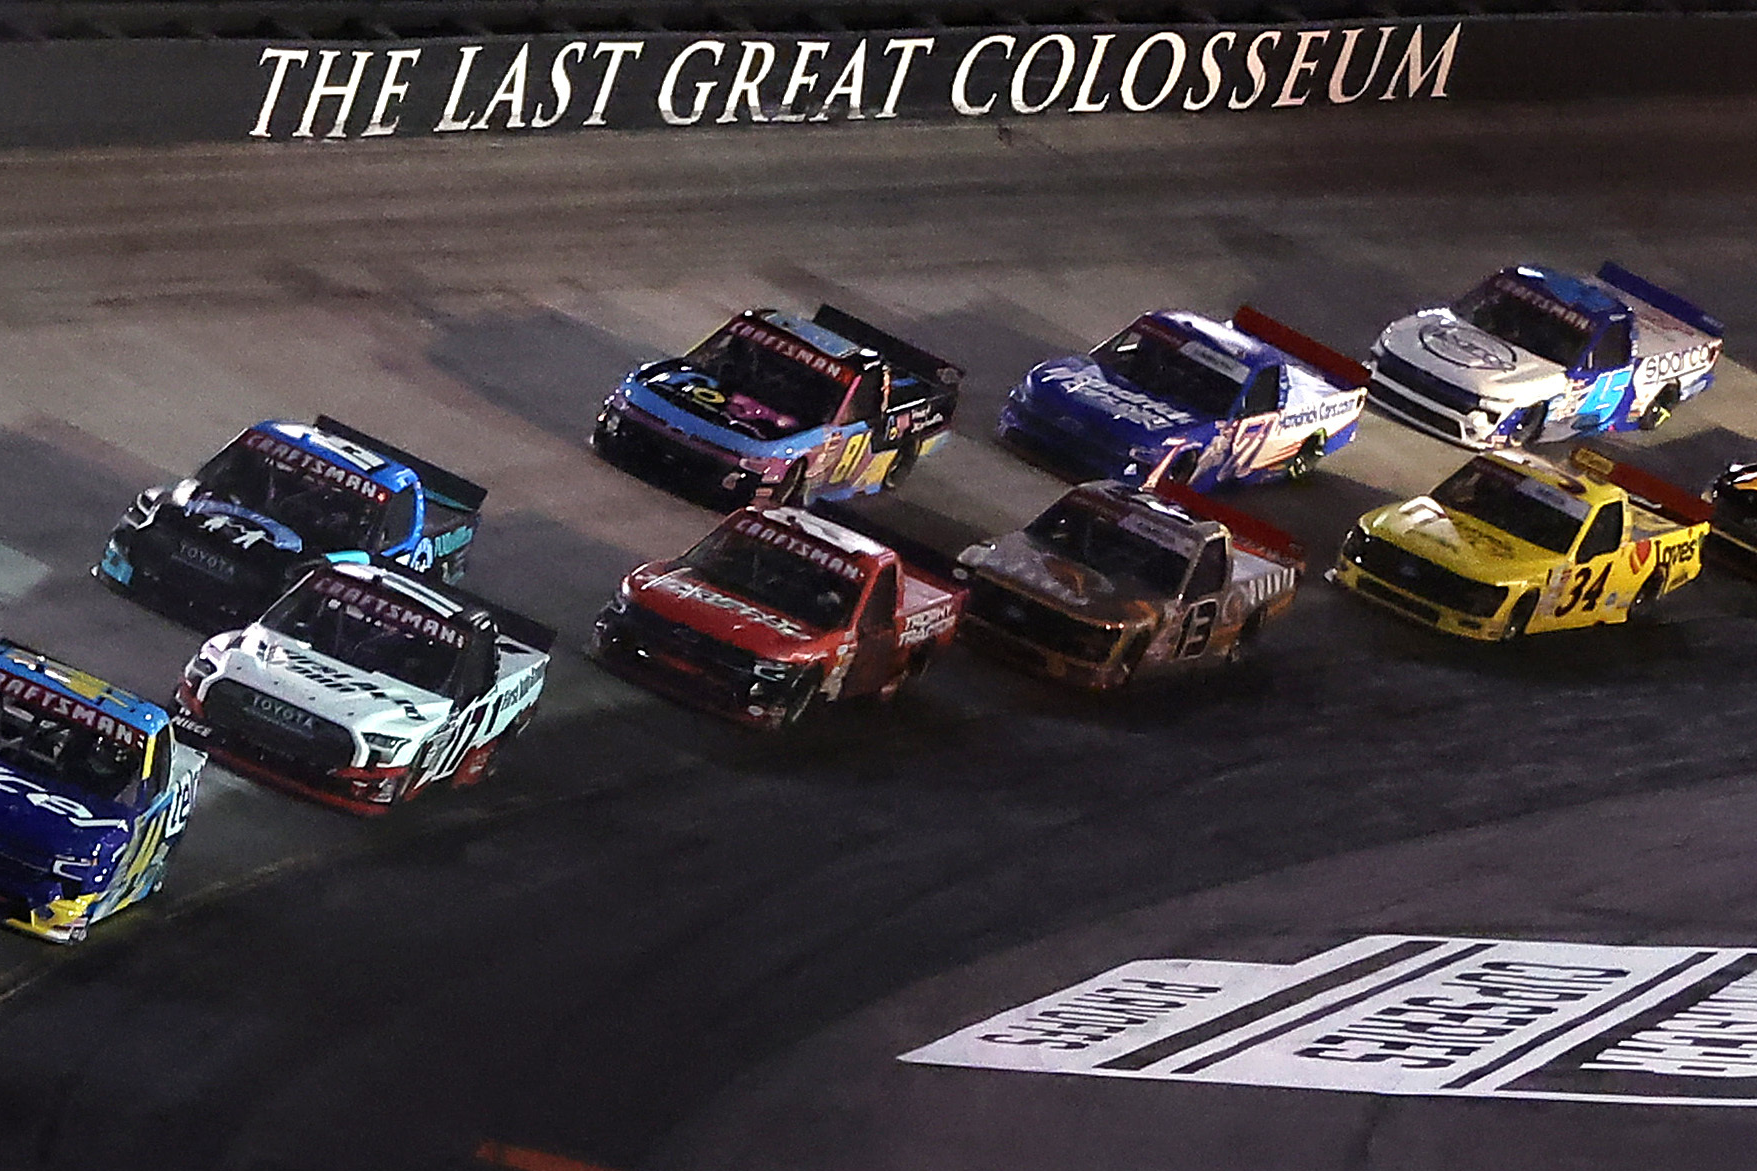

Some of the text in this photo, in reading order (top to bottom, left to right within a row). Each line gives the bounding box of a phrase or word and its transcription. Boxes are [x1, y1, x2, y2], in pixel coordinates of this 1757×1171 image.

[248, 22, 1462, 139] THE LAST GREAT COLOSSEUM
[729, 321, 842, 380] CRAFTSMAN
[245, 432, 379, 499] CRAFTSMAN
[734, 518, 860, 580] CRAFTSMAN
[314, 576, 465, 649] CRAFTSMAN
[1554, 560, 1614, 618] 34
[252, 696, 315, 730] TOYOTA
